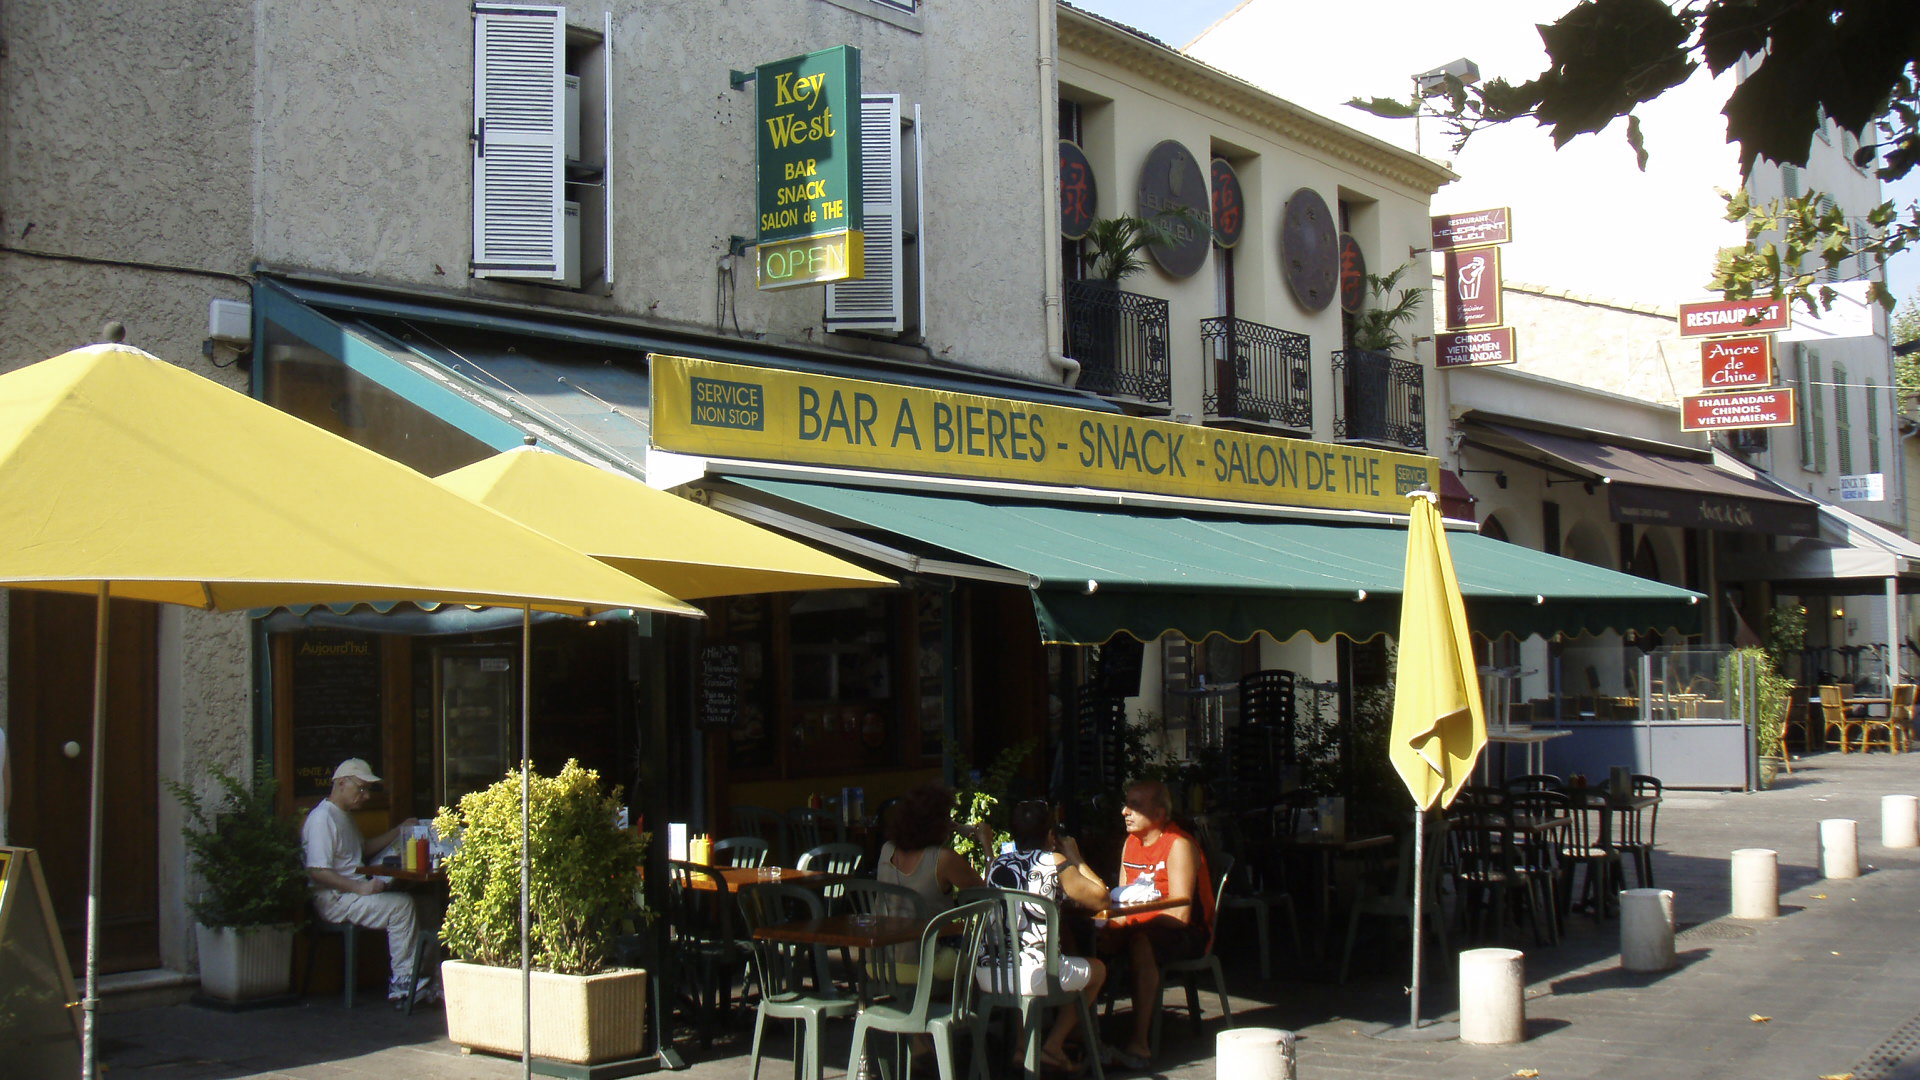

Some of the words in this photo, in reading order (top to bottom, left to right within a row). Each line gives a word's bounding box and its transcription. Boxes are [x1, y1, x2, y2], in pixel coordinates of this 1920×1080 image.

[775, 72, 826, 111] Key
[766, 106, 836, 150] West
[785, 158, 817, 181] BAR
[777, 179, 826, 206] SNACK
[761, 208, 798, 232] SALON
[803, 207, 817, 224] de
[822, 200, 844, 220] THE
[1448, 215, 1489, 226] RESTAURANT
[1452, 232, 1485, 242] BLEU
[766, 243, 846, 279] OPEN
[1455, 333, 1491, 345] CHINOIS
[1447, 342, 1500, 355] VIETNAMIEN
[1708, 344, 1759, 359] Ancre
[1445, 351, 1502, 364] THAILANDAIS
[1724, 357, 1744, 370] de
[1711, 370, 1757, 384] Chine
[696, 382, 758, 408] SERVICE
[1697, 395, 1776, 408] THAILANDAIS
[696, 405, 726, 424] NON
[728, 409, 759, 427] STOP
[1712, 405, 1761, 416] CHINOIS
[1697, 413, 1777, 425] VIETNAMIENS
[799, 386, 878, 447] BAR
[890, 398, 922, 450] A
[933, 402, 1046, 462] BIERES
[1079, 420, 1186, 478] SNACK
[1214, 439, 1298, 489] SALON
[1307, 451, 1336, 492] DE
[1341, 455, 1380, 497] THE
[1398, 466, 1426, 482] SERVICE
